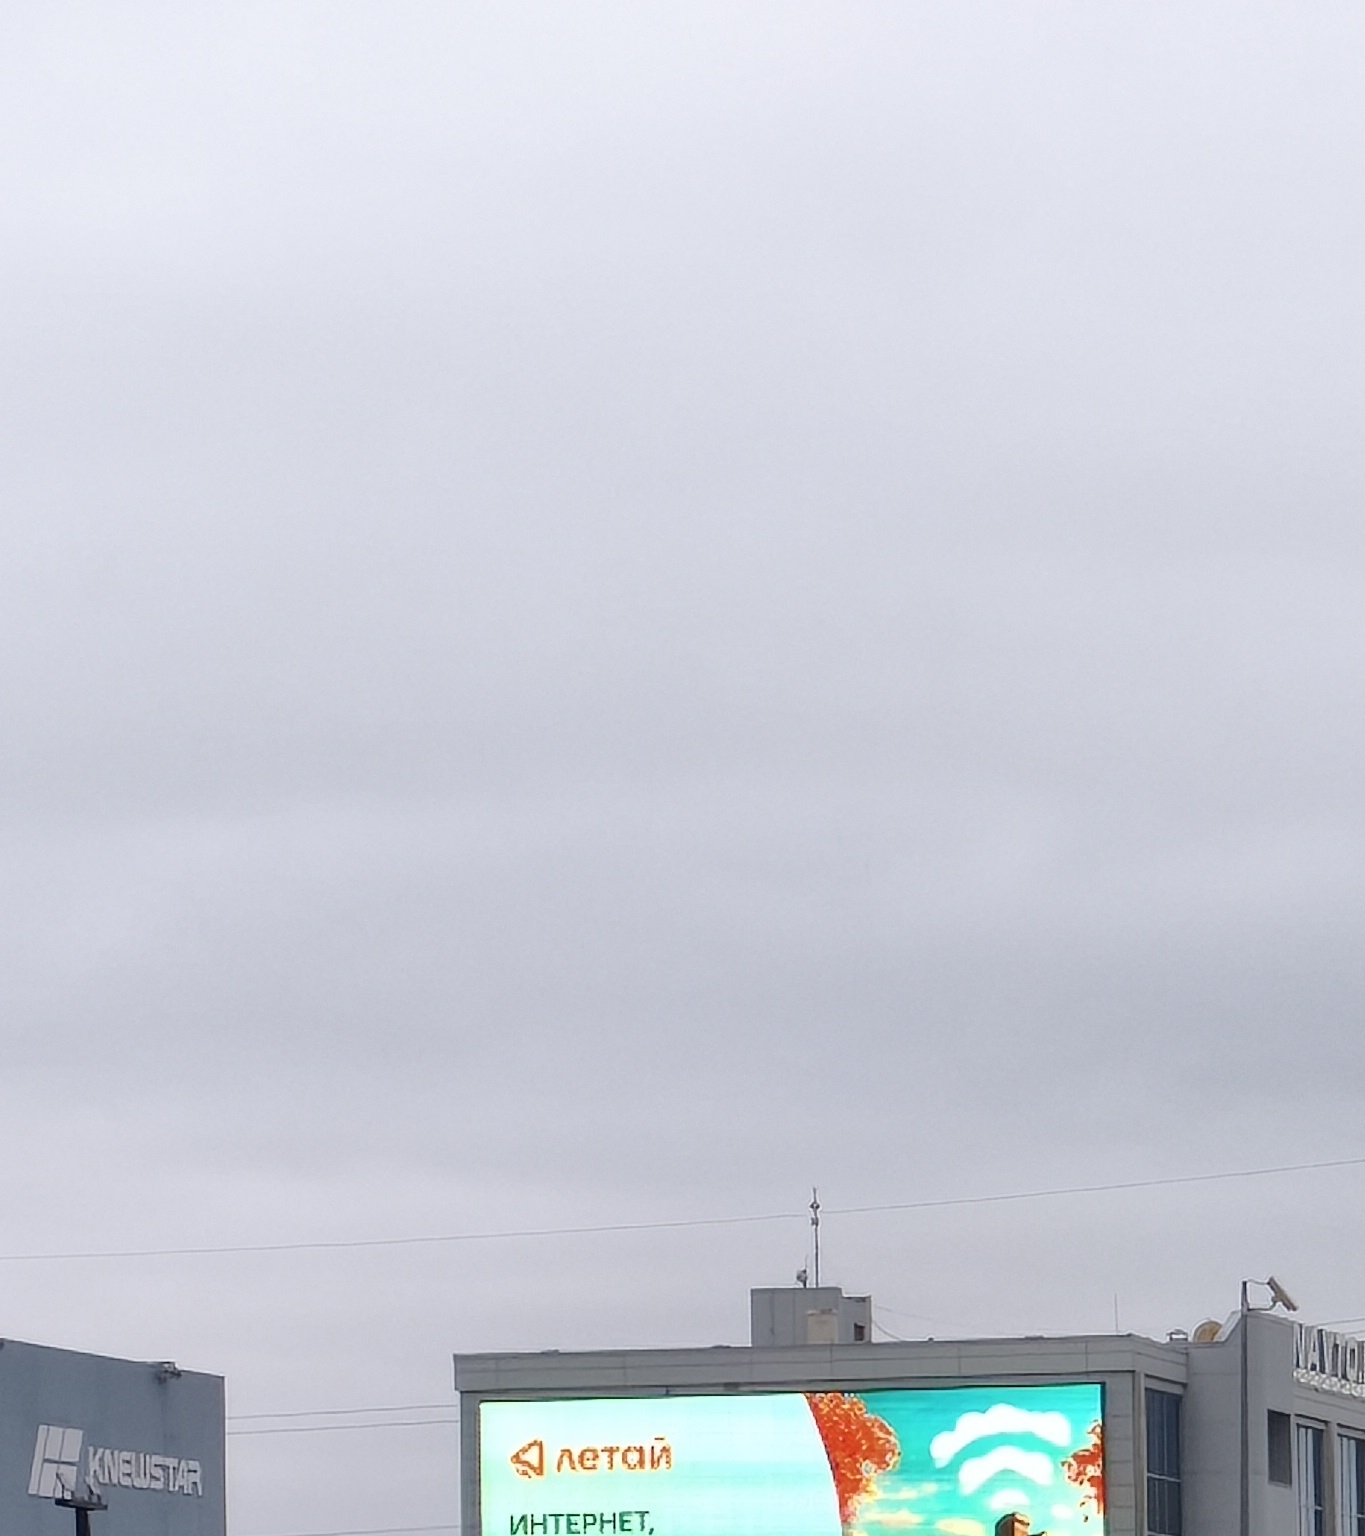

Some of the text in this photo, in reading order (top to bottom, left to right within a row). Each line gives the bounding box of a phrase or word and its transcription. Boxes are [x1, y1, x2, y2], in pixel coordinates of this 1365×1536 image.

[86, 1446, 203, 1497] KNEWSTAR
[556, 1436, 673, 1473] летай
[509, 1511, 655, 1536] ИНТЕРНЕТ,
